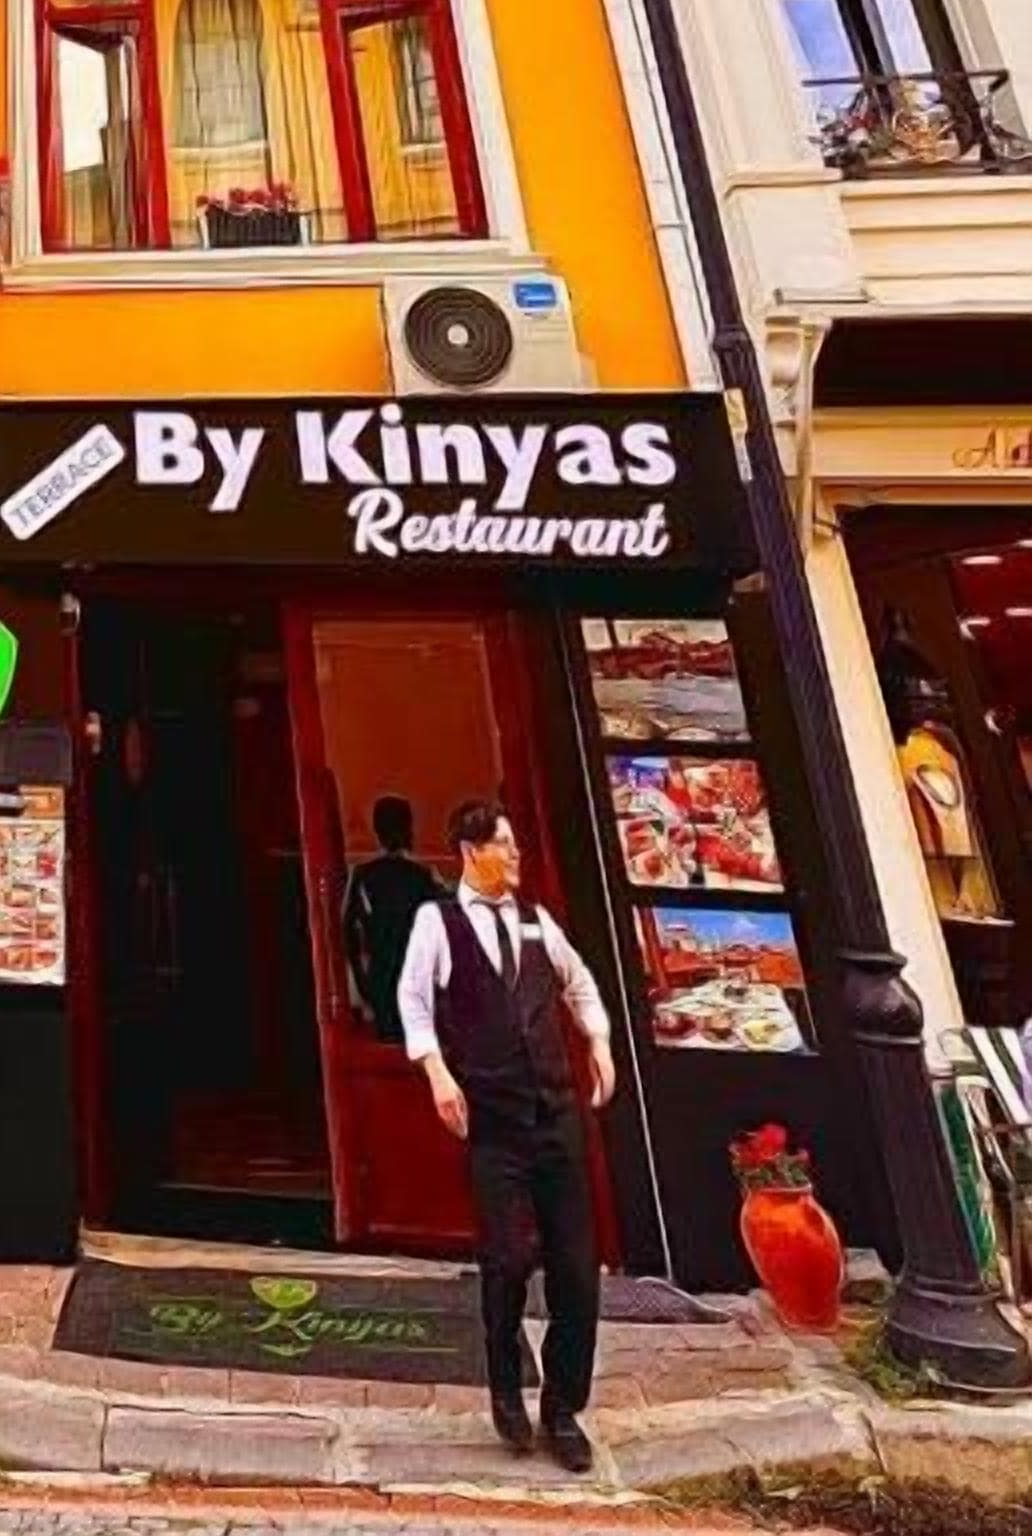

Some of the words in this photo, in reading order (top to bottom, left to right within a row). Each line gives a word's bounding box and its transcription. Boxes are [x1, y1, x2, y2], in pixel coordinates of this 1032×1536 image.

[13, 435, 114, 530] TERRACE
[133, 411, 265, 512] By
[295, 403, 677, 511] Kinyas
[348, 488, 670, 558] Restaurant
